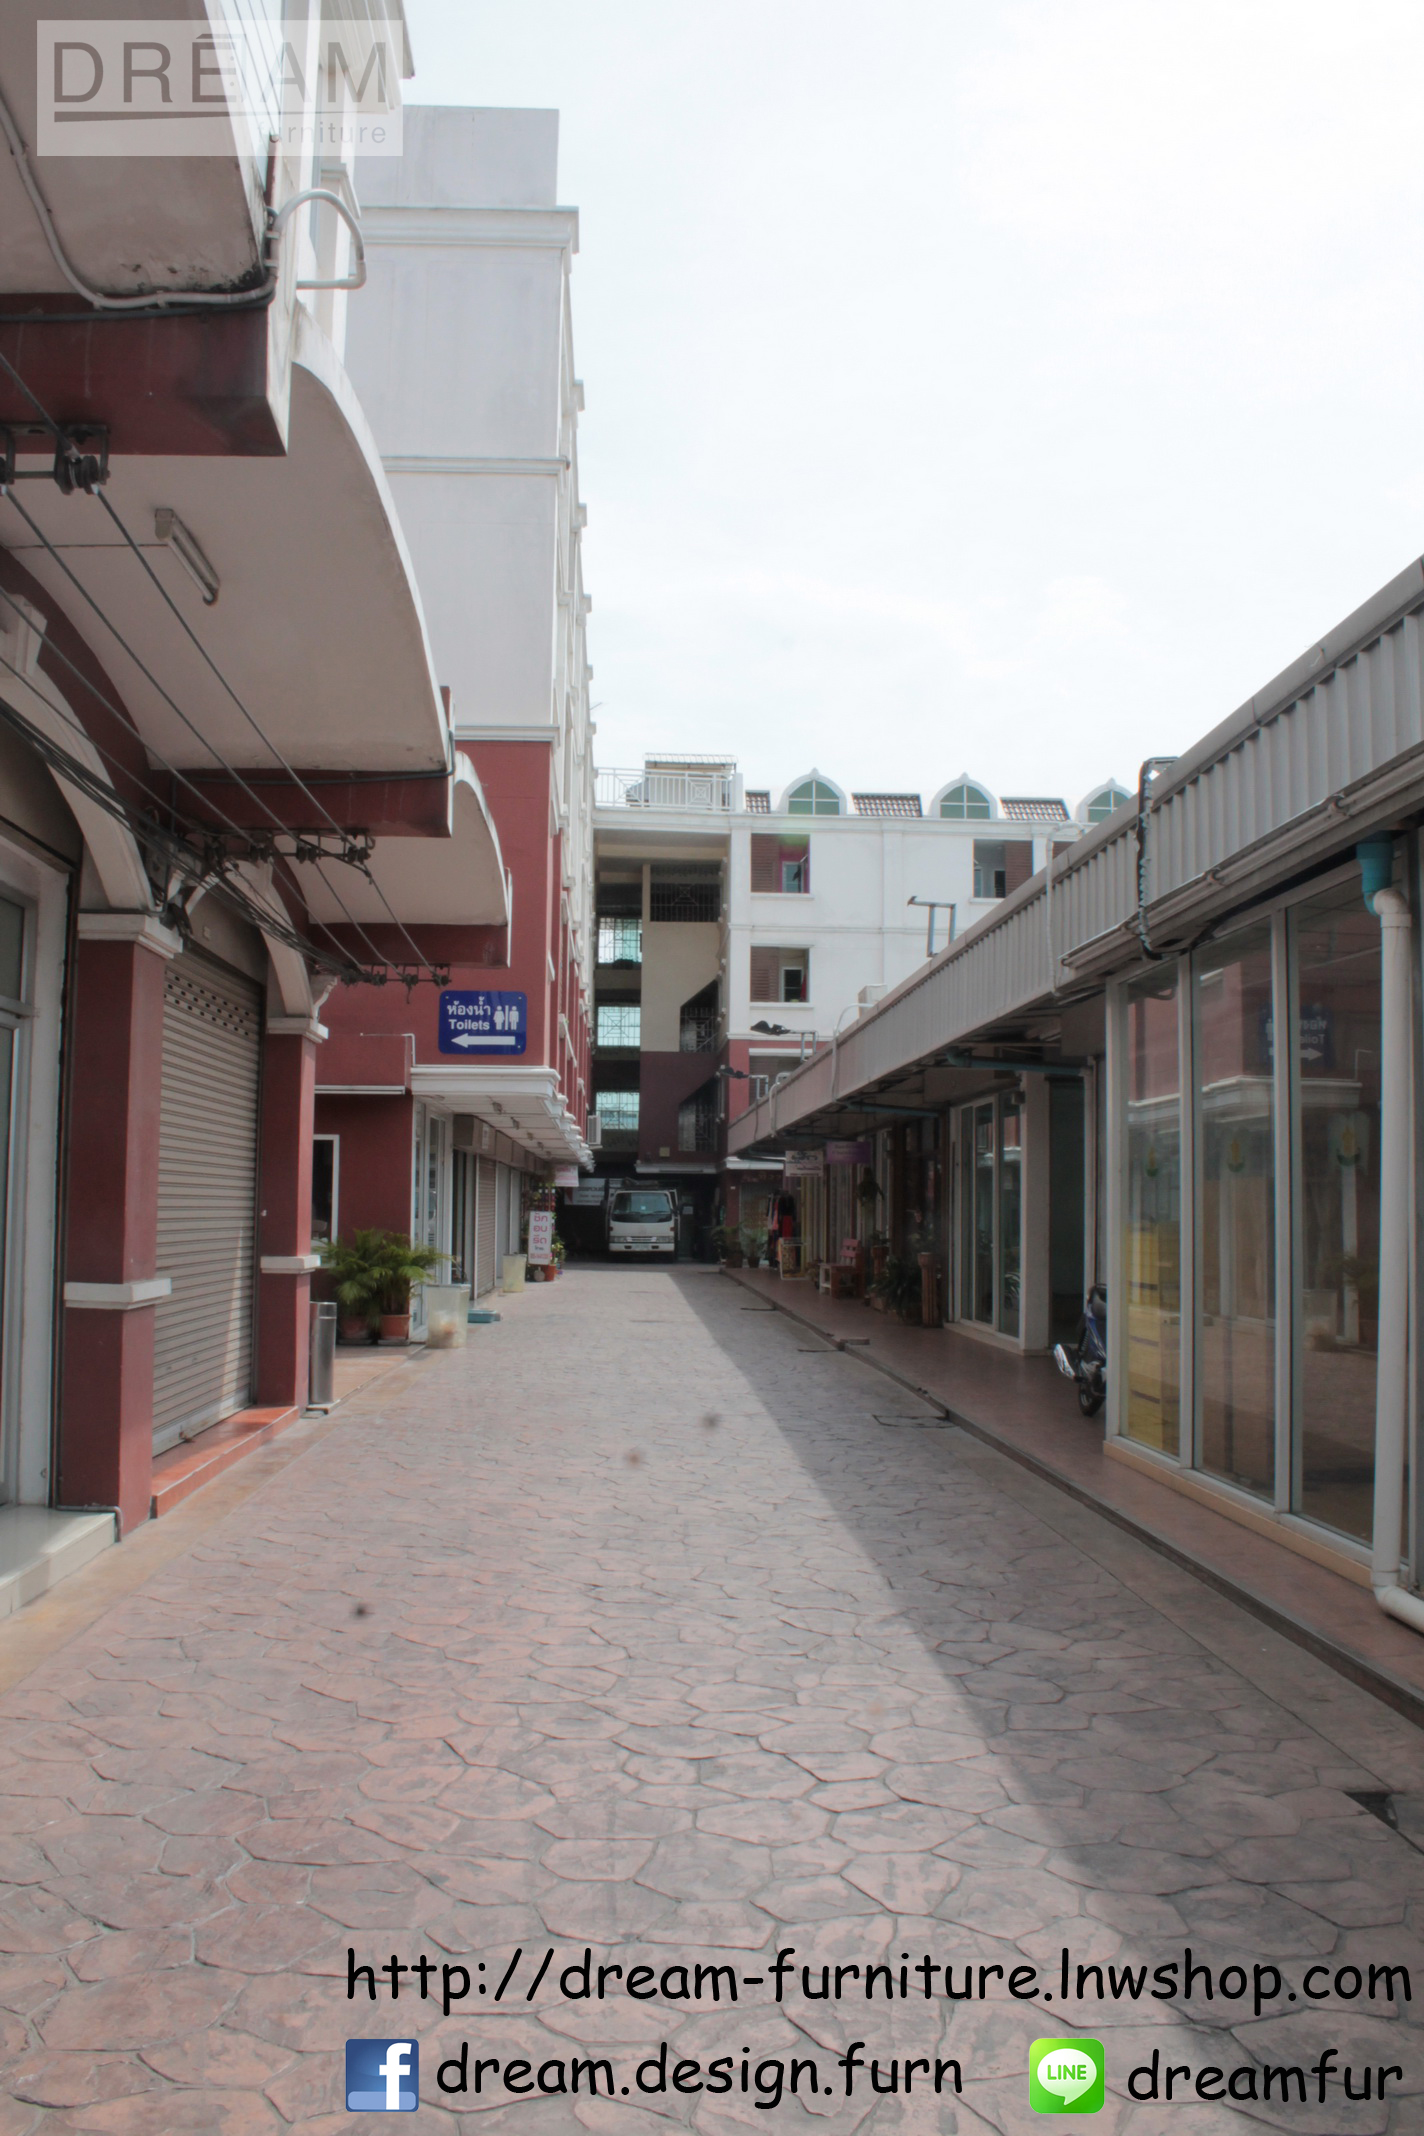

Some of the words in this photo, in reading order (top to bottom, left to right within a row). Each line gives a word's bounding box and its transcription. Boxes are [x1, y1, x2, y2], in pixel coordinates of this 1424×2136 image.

[446, 996, 491, 1016] ห้องน้ำ
[448, 1018, 490, 1031] Toilets
